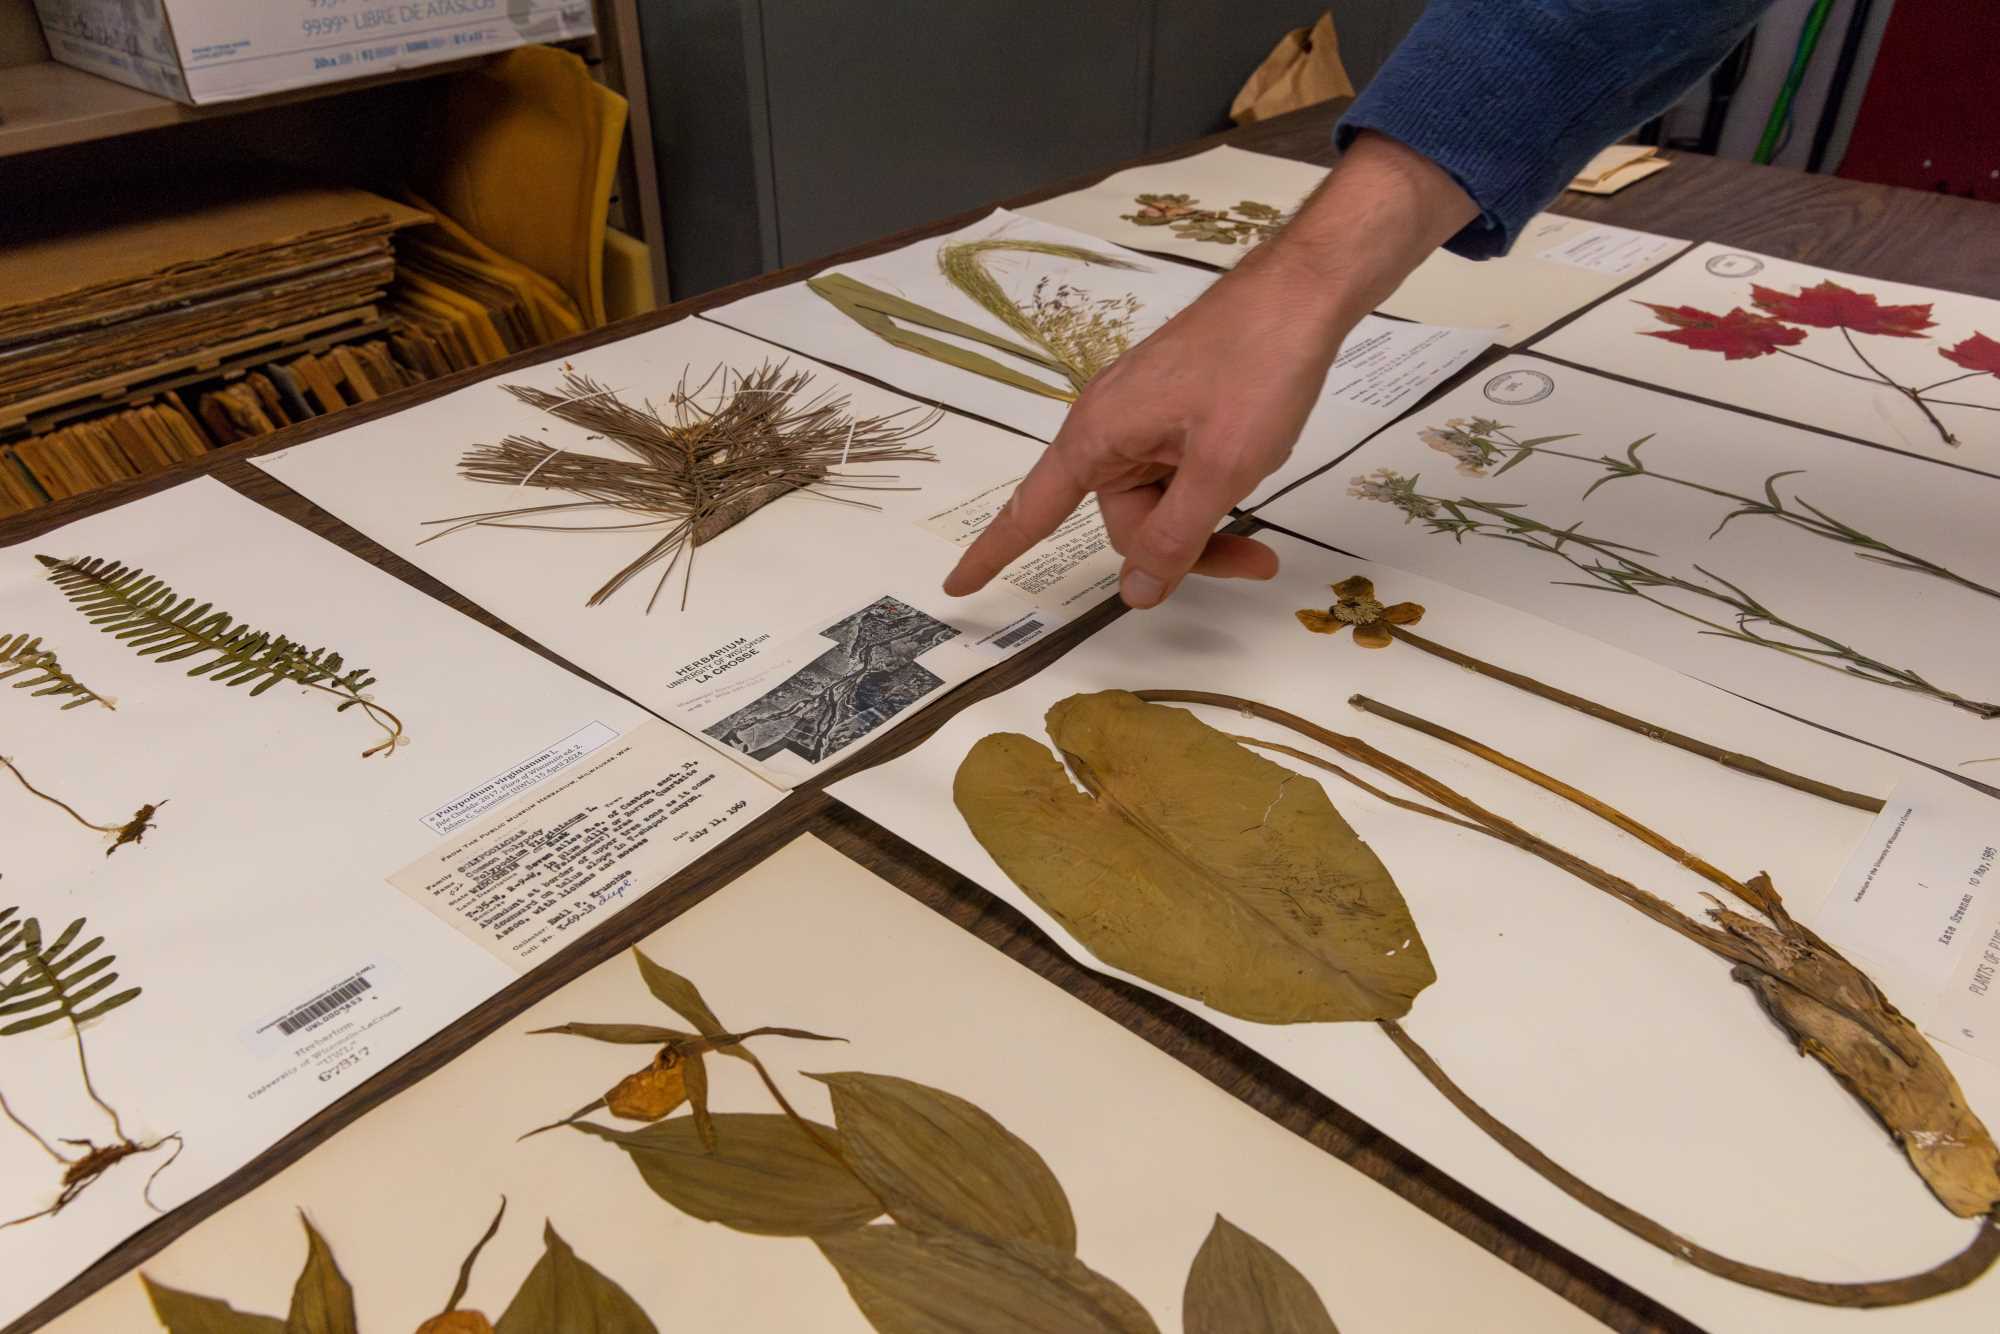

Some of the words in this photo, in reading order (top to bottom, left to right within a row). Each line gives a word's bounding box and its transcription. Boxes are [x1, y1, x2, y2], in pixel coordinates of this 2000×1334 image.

[354, 7, 397, 30] LIBRE
[400, 4, 424, 22] DE
[666, 663, 714, 689] UNIVERSITY
[714, 656, 724, 667] OF
[725, 633, 771, 659] WISCONSIN
[676, 637, 747, 676] HERBARIUM
[695, 674, 714, 684] LA
[712, 648, 761, 675] CROSSE
[528, 754, 564, 775] Wisconsin
[435, 784, 494, 818] Polypodium
[494, 754, 551, 785] virginianum
[442, 817, 466, 833] Adam
[546, 760, 567, 776] April
[563, 751, 585, 766] 2024
[623, 798, 655, 818] Barron
[655, 769, 698, 797] Quartzite
[525, 853, 554, 871] Seven
[555, 834, 582, 852] miles
[620, 789, 656, 810] Canton,
[546, 832, 570, 848] Rusk
[612, 819, 633, 832] area
[672, 831, 689, 842] Date
[688, 828, 709, 842] July
[709, 817, 727, 827] 11,
[726, 800, 746, 815] 1969
[465, 857, 500, 878] Common
[502, 828, 544, 856] Polypody
[472, 848, 529, 884] Polypodium
[527, 812, 588, 849] Virginianum
[479, 899, 525, 929] Abundant
[541, 866, 574, 888] border
[592, 838, 618, 855] upper
[620, 823, 641, 836] tree
[643, 808, 664, 822] zone
[691, 774, 716, 790] comes
[493, 900, 538, 930] downward
[555, 871, 584, 889] talus
[586, 852, 612, 870] slope
[626, 815, 668, 842] V-shaped
[670, 794, 702, 815] canyon.
[425, 874, 452, 891] Family
[433, 882, 455, 896] Name
[456, 898, 477, 912] Land
[476, 872, 518, 899] Description
[468, 862, 520, 894] WISCONSIN
[495, 918, 530, 940] Assoc.
[532, 899, 557, 915] with
[557, 873, 596, 898] lichens
[598, 859, 616, 872] and
[617, 838, 648, 859] mosses
[547, 909, 572, 926] Emil
[589, 870, 632, 899] Kruschke
[448, 893, 468, 906] State
[472, 900, 505, 922] Remarks
[1938, 926, 1956, 945] Kate
[1968, 877, 1980, 887] 10
[247, 1068, 298, 1100] University
[300, 1056, 313, 1069] of
